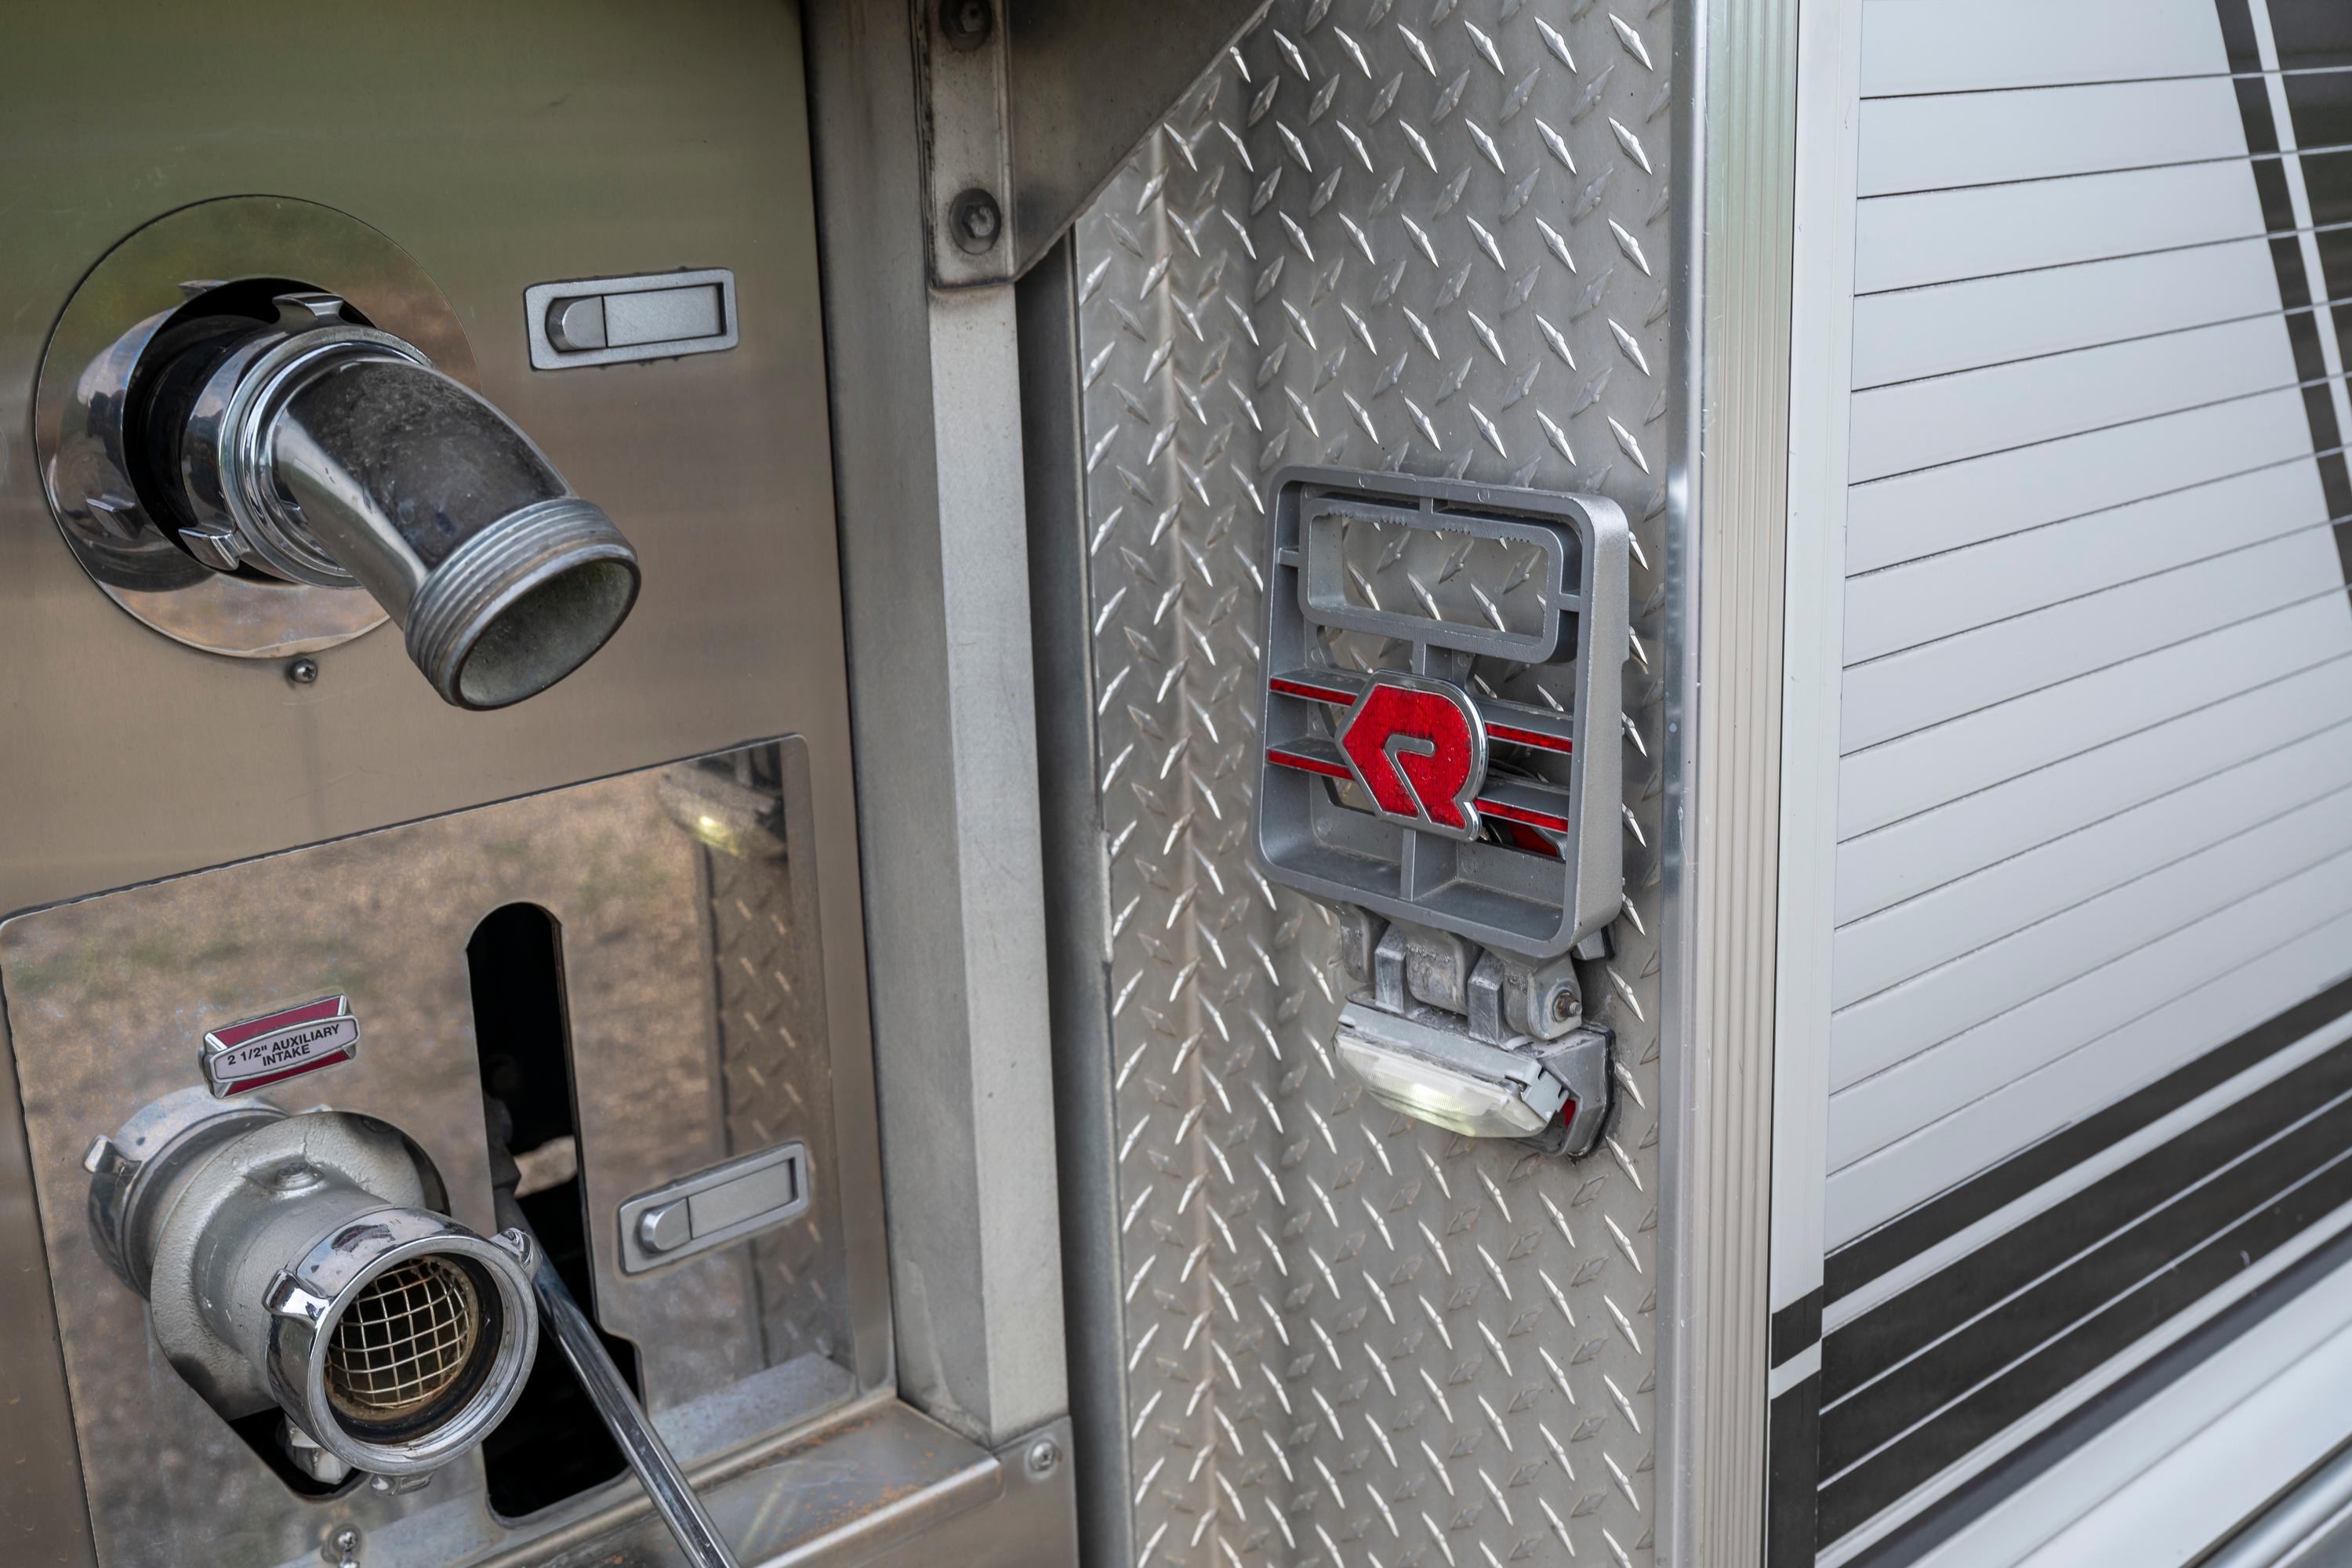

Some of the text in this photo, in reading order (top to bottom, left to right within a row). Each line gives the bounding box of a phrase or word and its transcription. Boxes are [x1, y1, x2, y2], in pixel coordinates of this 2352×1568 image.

[227, 1024, 339, 1065] 2 1/2" AUXILIARY
[263, 1044, 310, 1066] INTAKE
